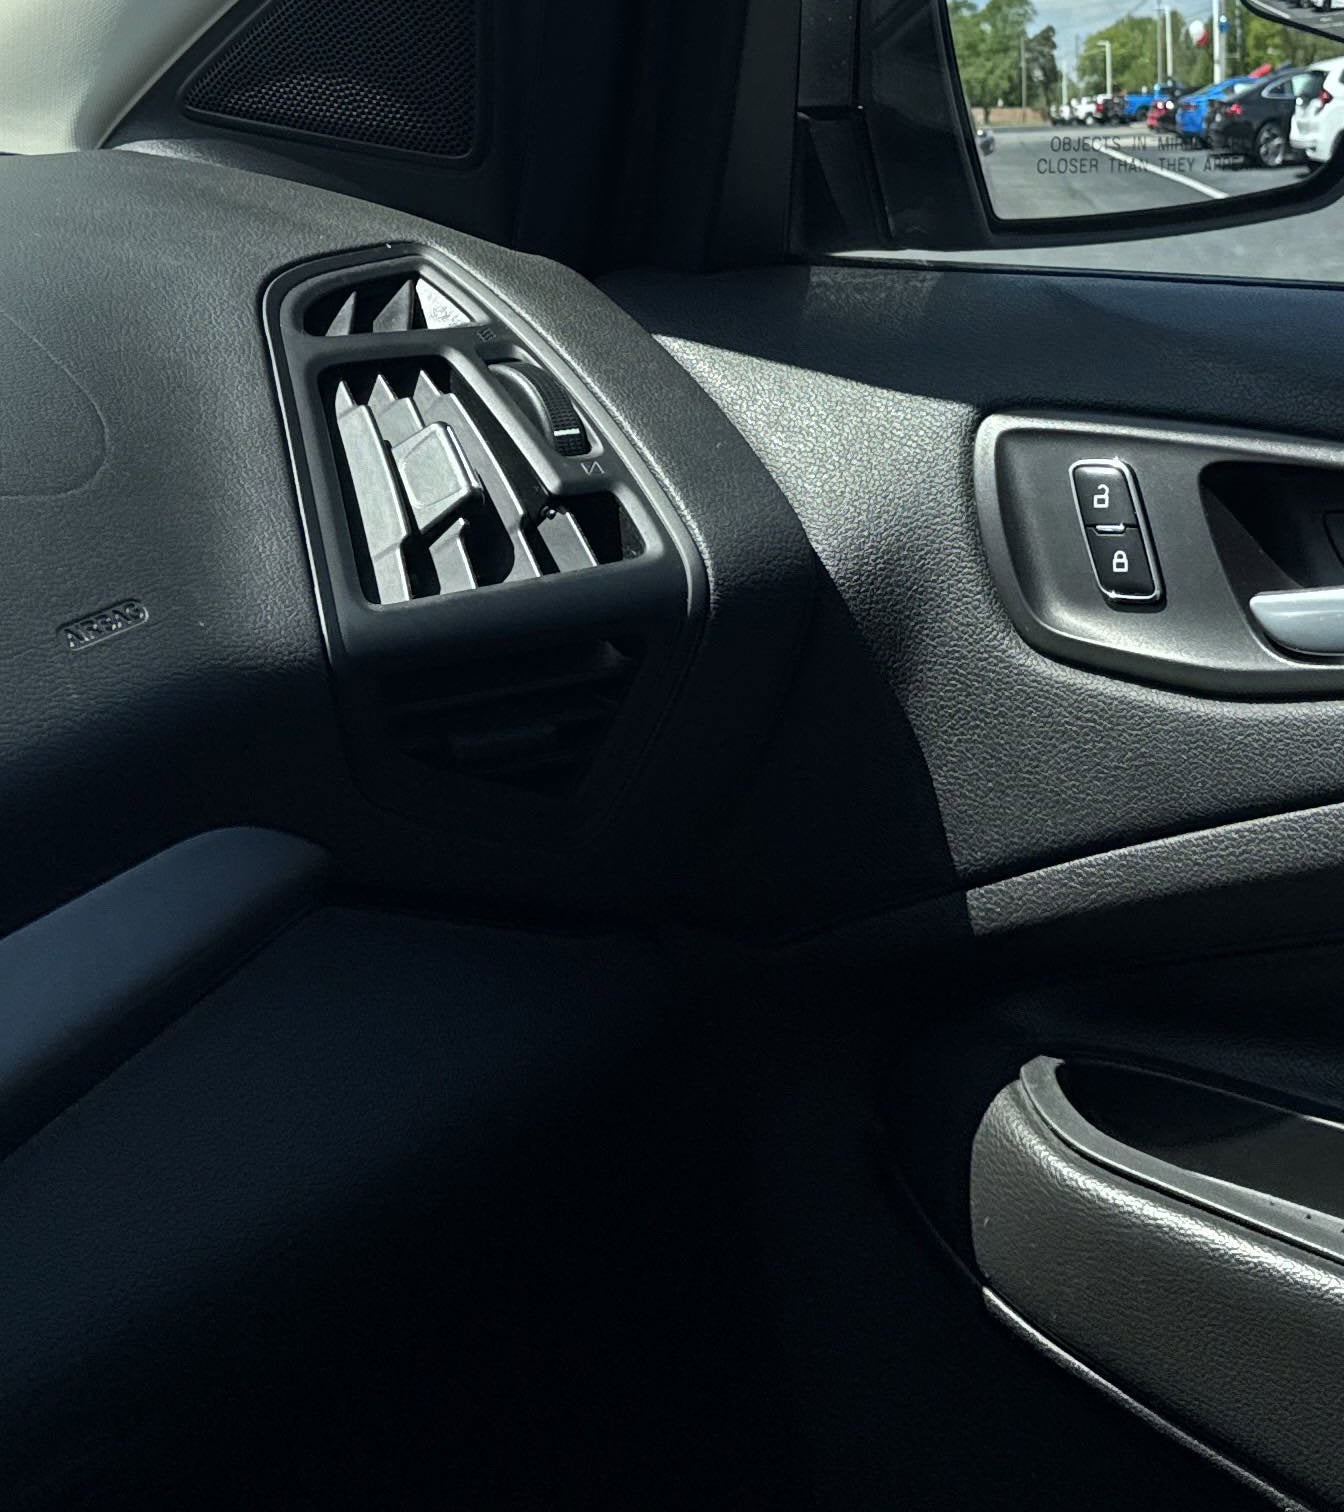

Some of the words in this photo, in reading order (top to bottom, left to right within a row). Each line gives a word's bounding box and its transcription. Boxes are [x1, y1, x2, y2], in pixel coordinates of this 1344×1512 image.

[1049, 135, 1121, 153] OBJECTS
[1132, 135, 1148, 152] IN
[1036, 157, 1099, 175] CLOSER
[1158, 157, 1196, 173] THEY
